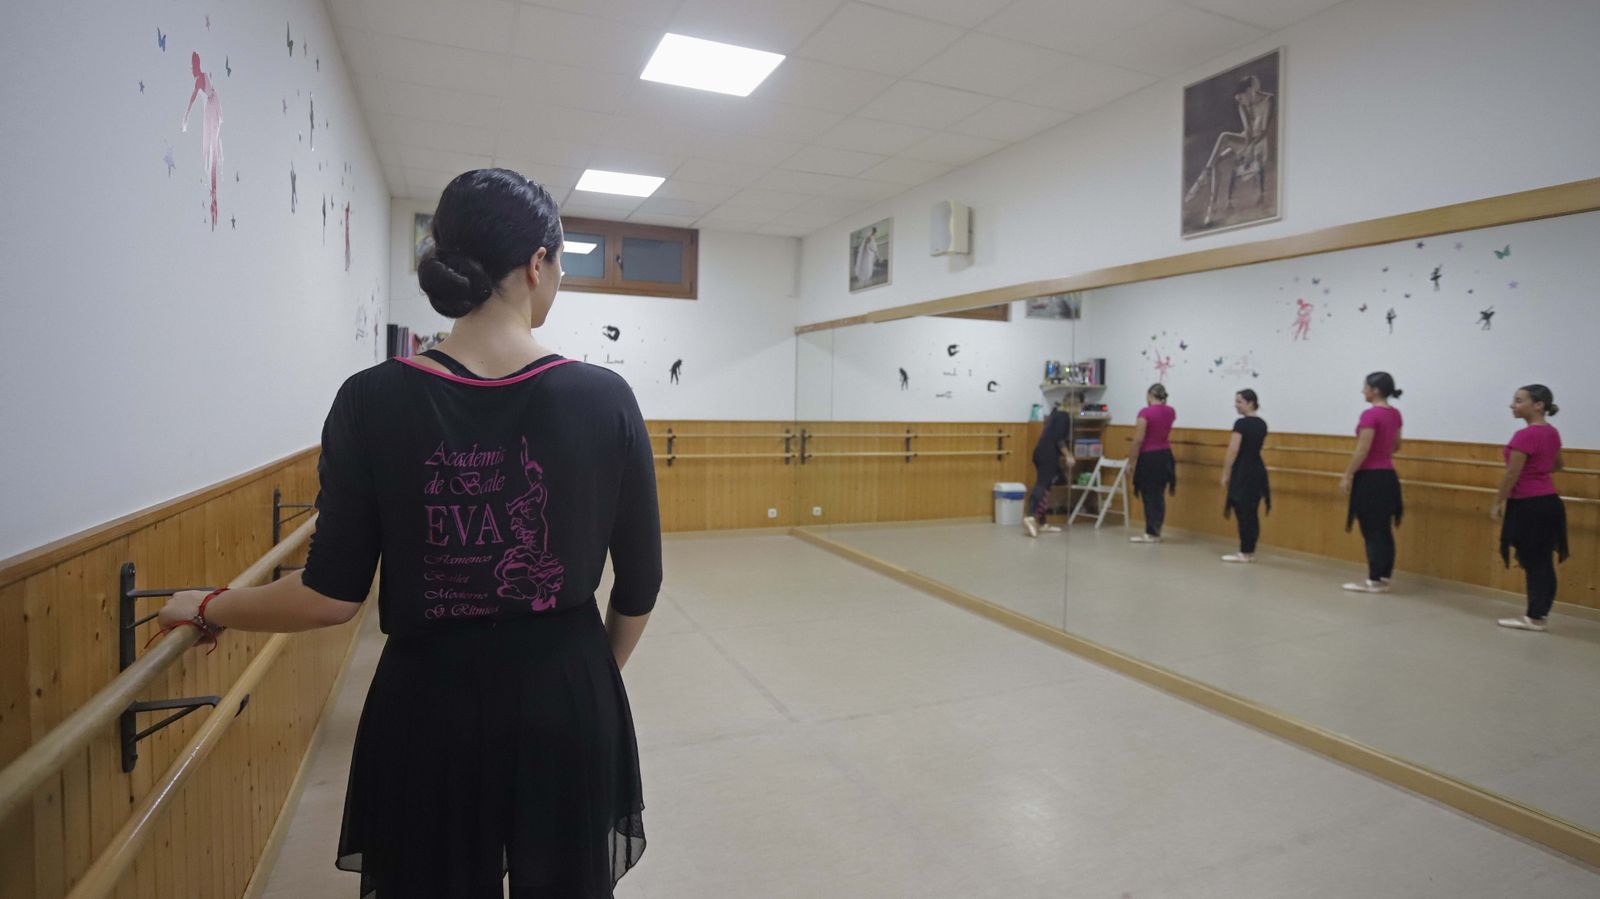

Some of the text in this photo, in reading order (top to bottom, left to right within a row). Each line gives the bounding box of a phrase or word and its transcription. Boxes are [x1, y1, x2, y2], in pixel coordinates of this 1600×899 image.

[424, 469, 506, 496] de Baile
[423, 503, 505, 547] EVA
[423, 553, 493, 565] Flamenco
